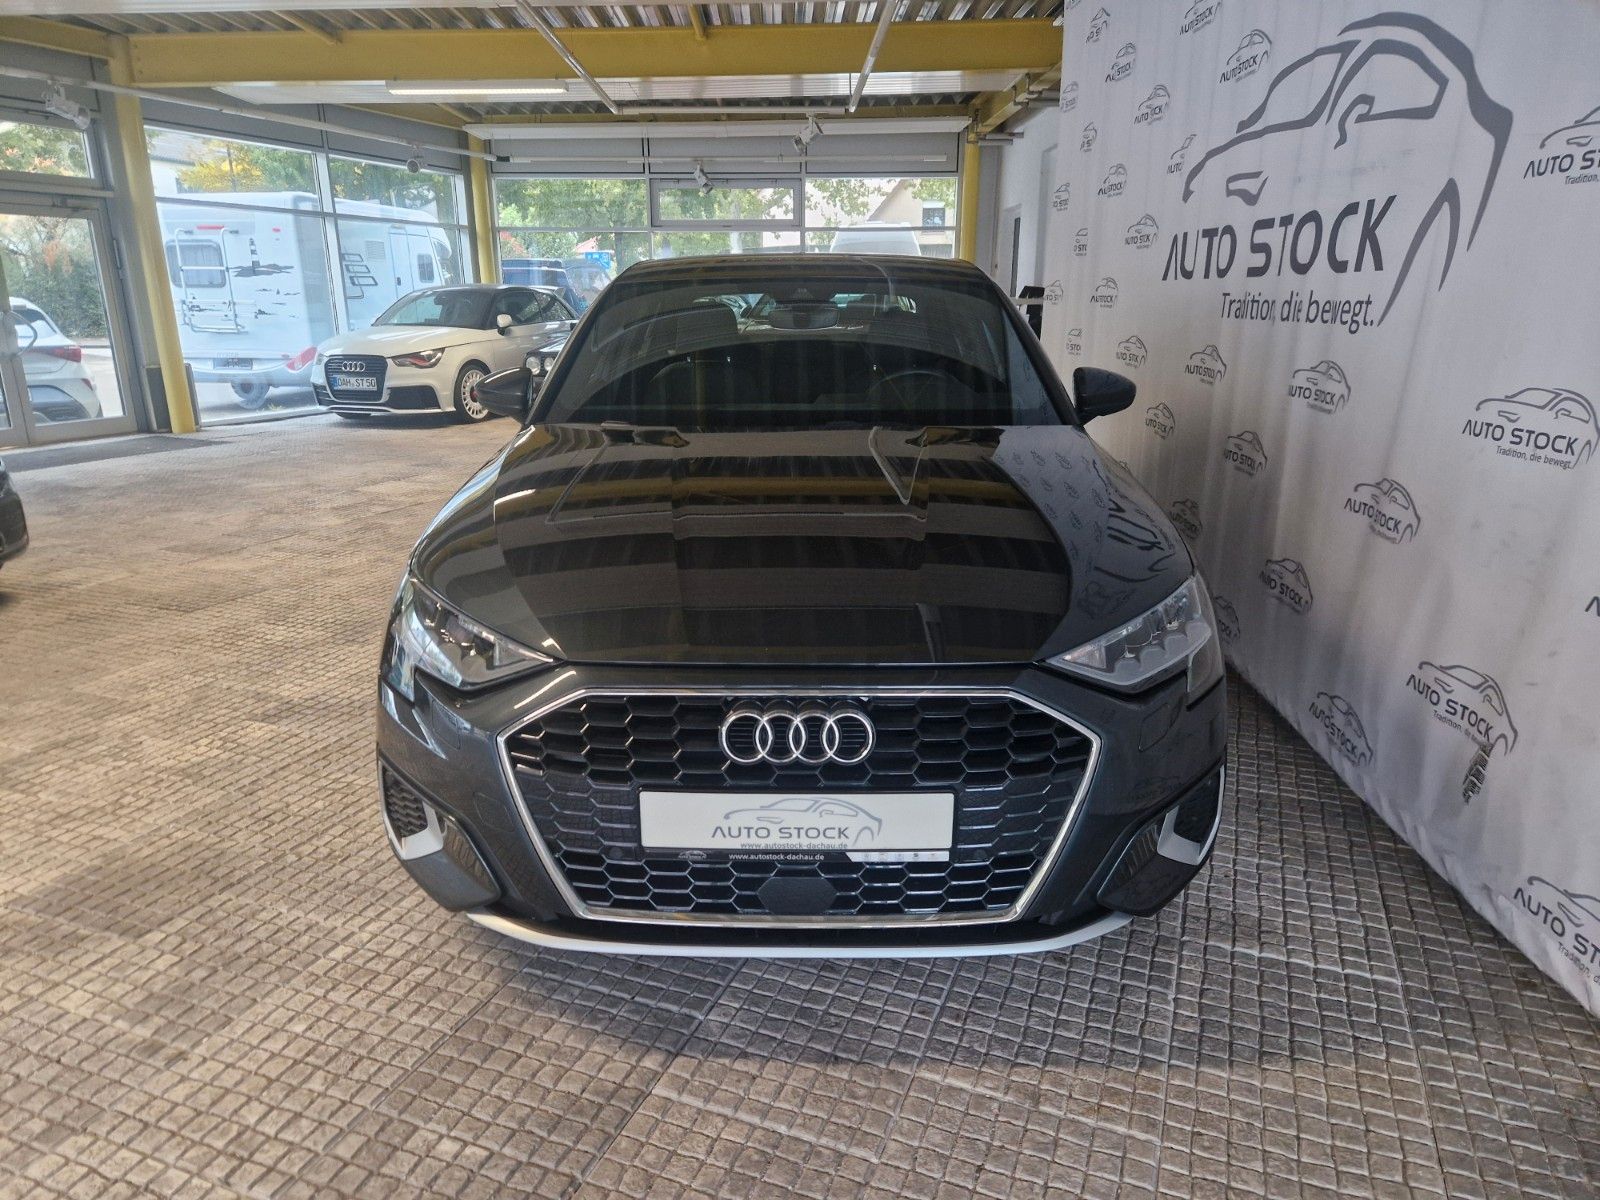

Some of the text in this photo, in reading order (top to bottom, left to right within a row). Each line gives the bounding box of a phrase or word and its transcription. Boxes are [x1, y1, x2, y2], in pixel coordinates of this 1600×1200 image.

[1523, 153, 1574, 179] AUTO
[1162, 194, 1397, 281] AUTO STOCK
[1280, 290, 1301, 322] die
[1305, 290, 1374, 334] bewegt.
[355, 379, 364, 387] ST
[1462, 419, 1579, 456] AUTO STOCK
[1496, 445, 1527, 460] Tradition,
[1529, 452, 1542, 463] die
[1344, 498, 1375, 518] AUTO
[1406, 674, 1441, 706] AUTO
[1445, 698, 1494, 742] STOCK
[711, 826, 850, 840] AUTO STOCK
[728, 852, 825, 861] www.autostock-dachau.de
[740, 842, 848, 850] www.autostock-dachau.de
[1513, 887, 1566, 938] AUTO
